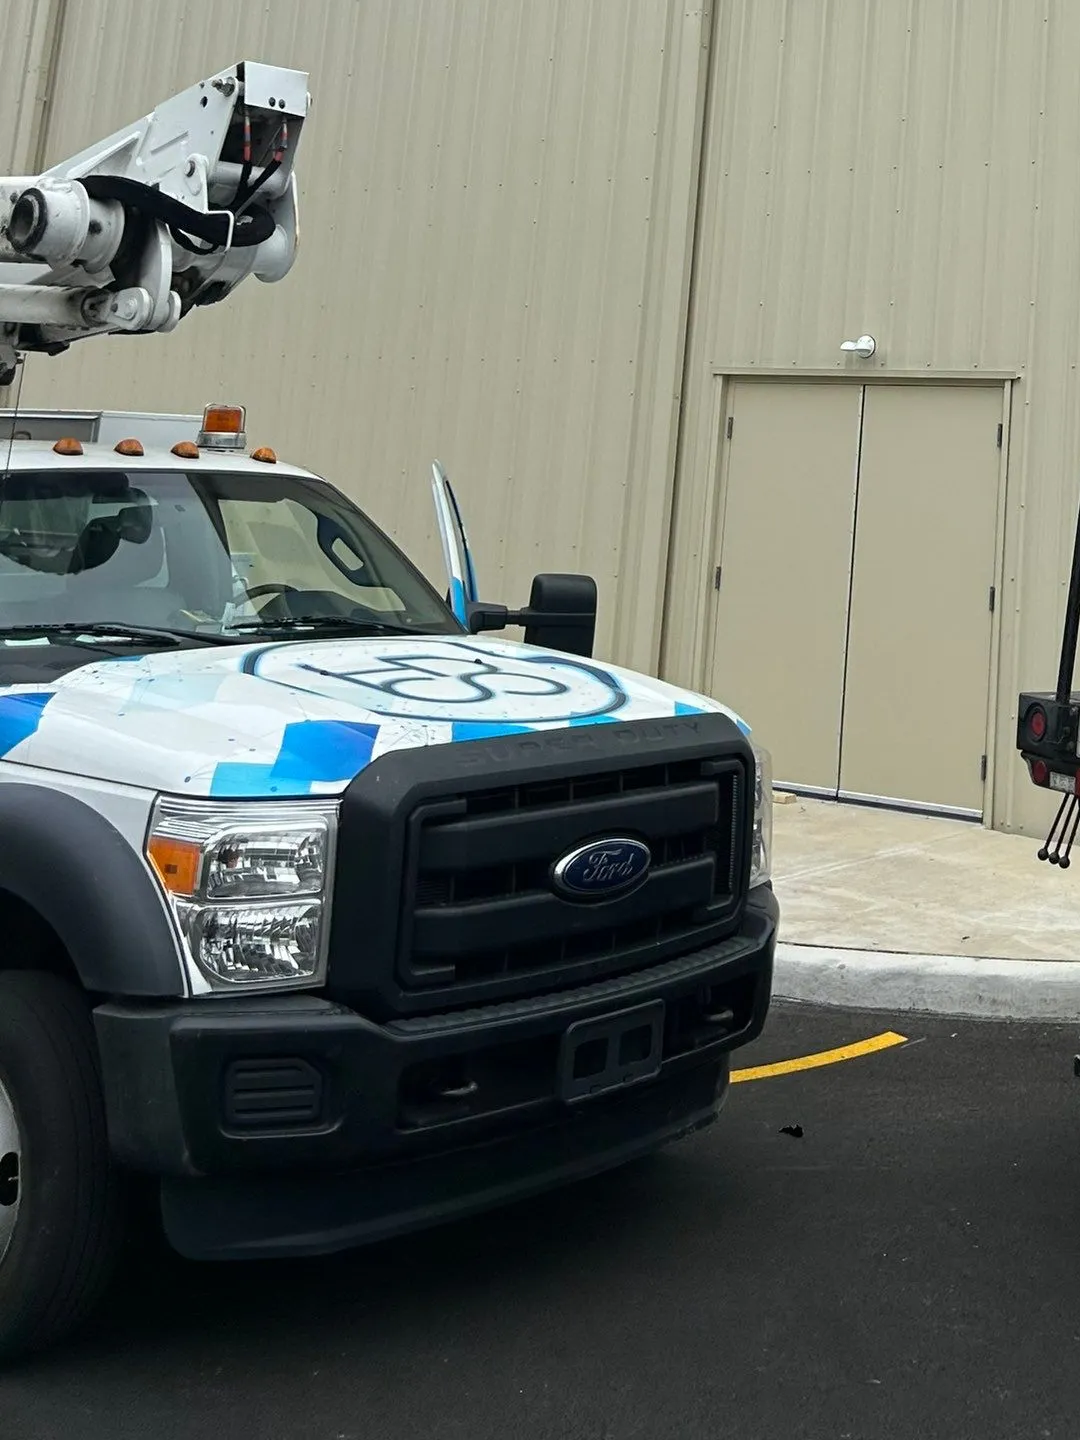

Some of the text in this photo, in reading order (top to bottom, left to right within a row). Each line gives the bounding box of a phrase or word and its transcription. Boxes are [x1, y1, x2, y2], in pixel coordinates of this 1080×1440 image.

[455, 721, 702, 767] SUPER DUTY
[583, 848, 635, 882] Ford
